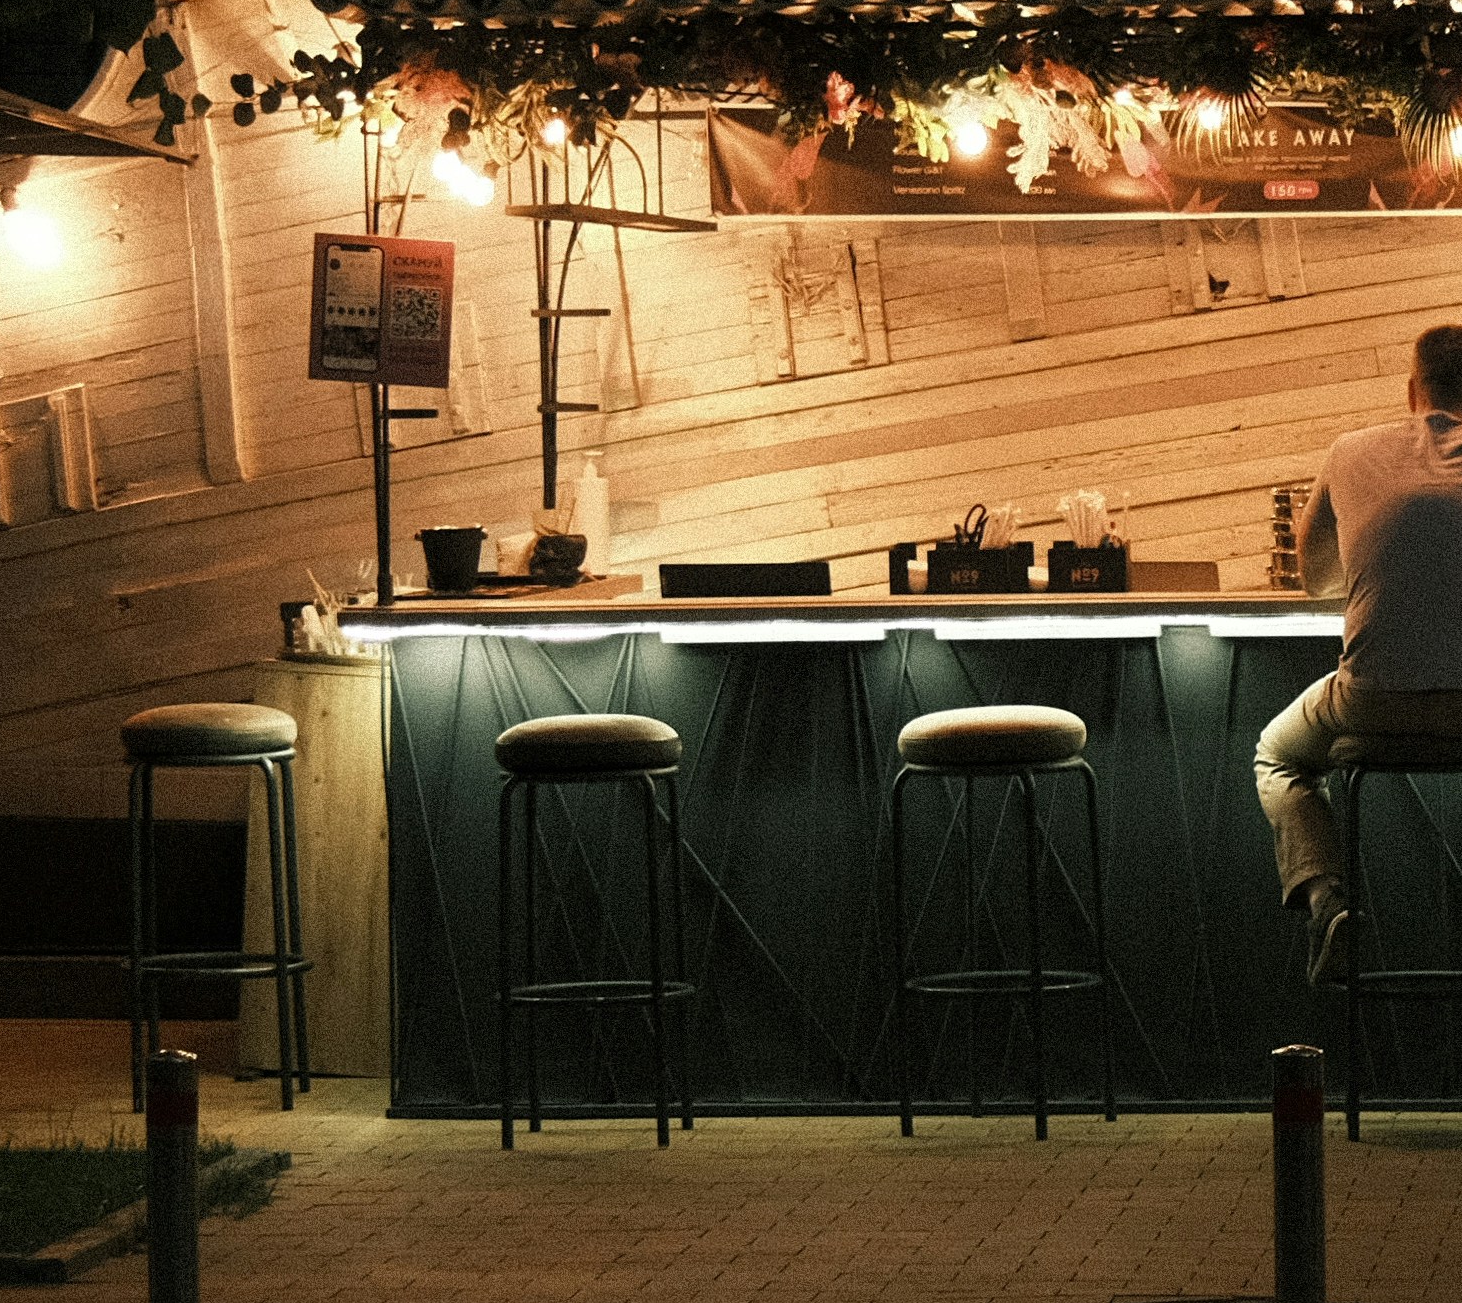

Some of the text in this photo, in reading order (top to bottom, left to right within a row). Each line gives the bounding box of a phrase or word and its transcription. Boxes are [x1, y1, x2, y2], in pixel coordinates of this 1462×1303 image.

[1224, 128, 1355, 147] TAKE AWAY
[1271, 185, 1296, 197] 150
